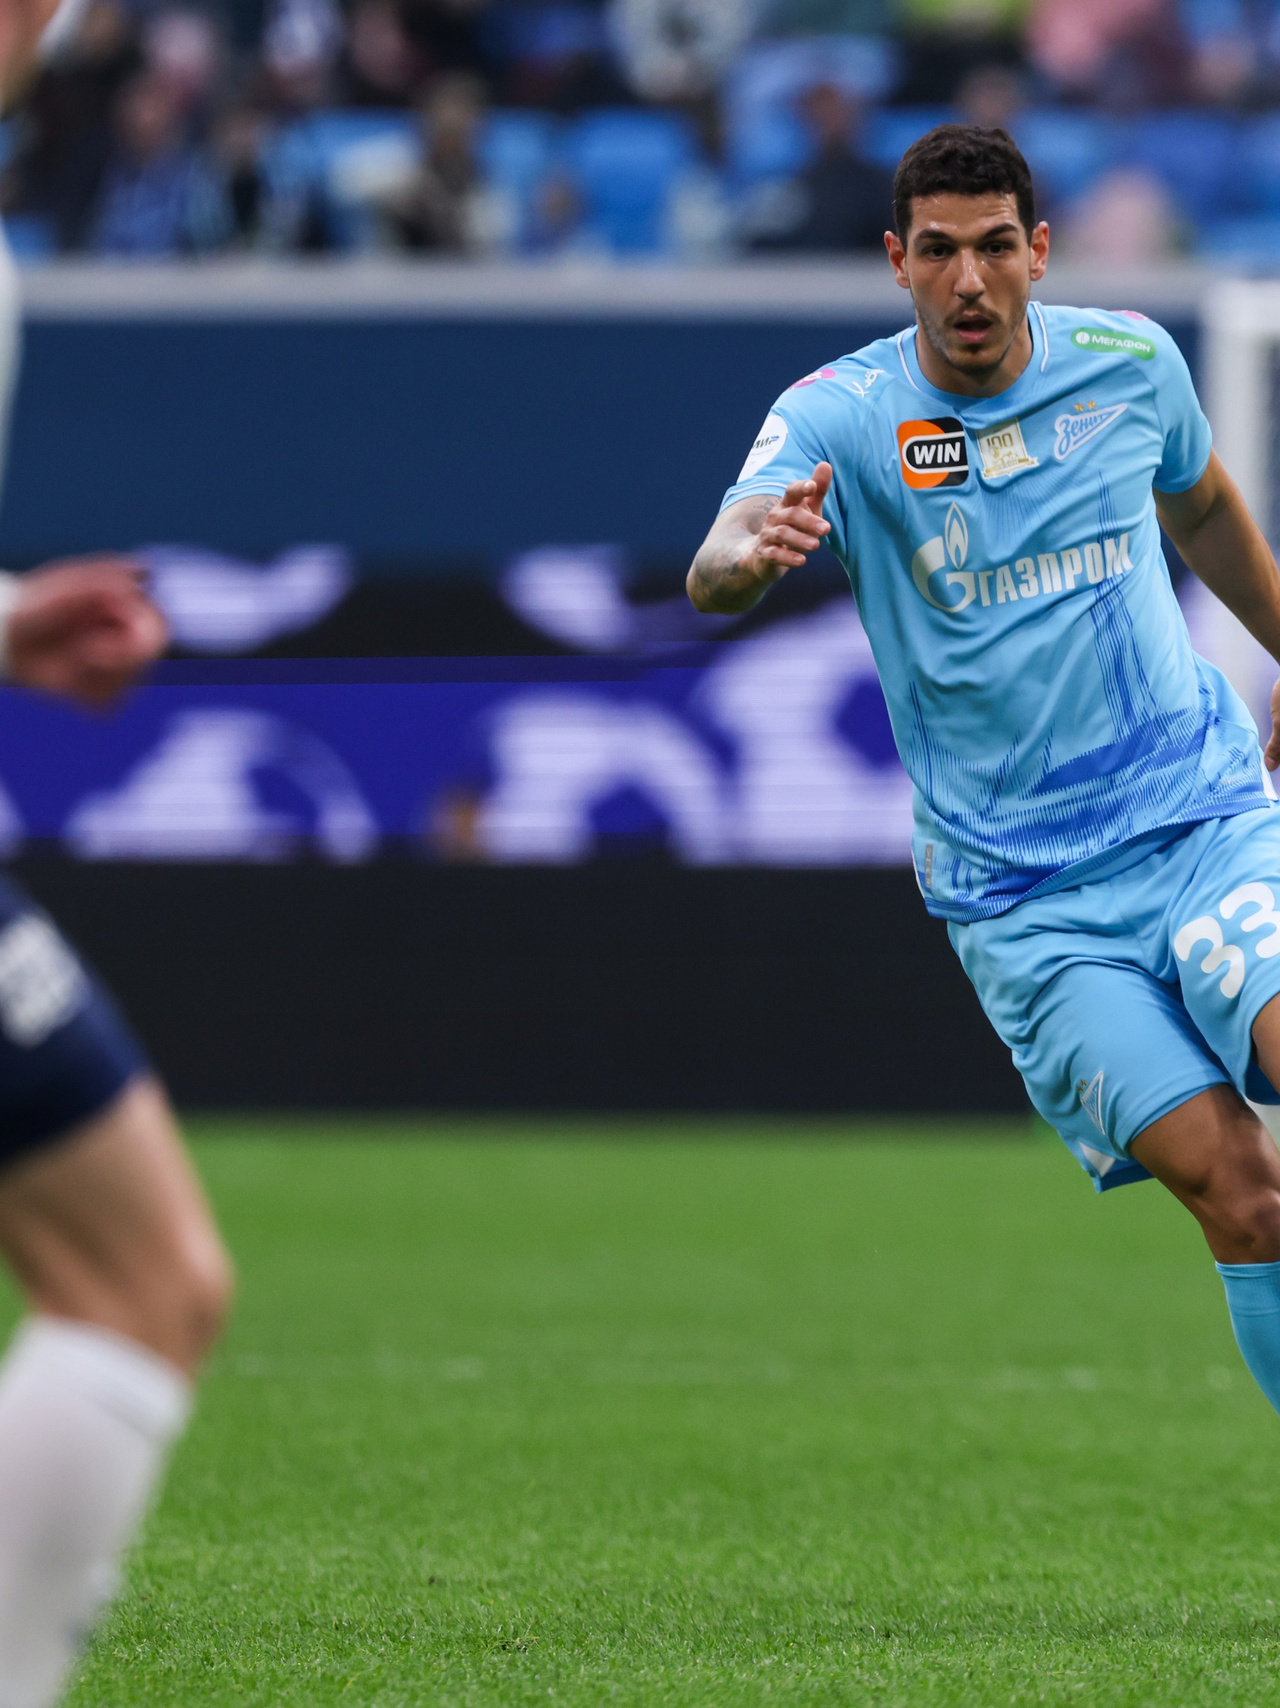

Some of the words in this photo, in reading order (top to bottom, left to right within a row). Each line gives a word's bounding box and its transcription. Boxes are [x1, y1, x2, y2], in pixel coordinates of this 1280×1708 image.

[986, 432, 1014, 448] 100
[913, 441, 961, 465] WIN
[977, 532, 1134, 607] ГАЗПРОМ
